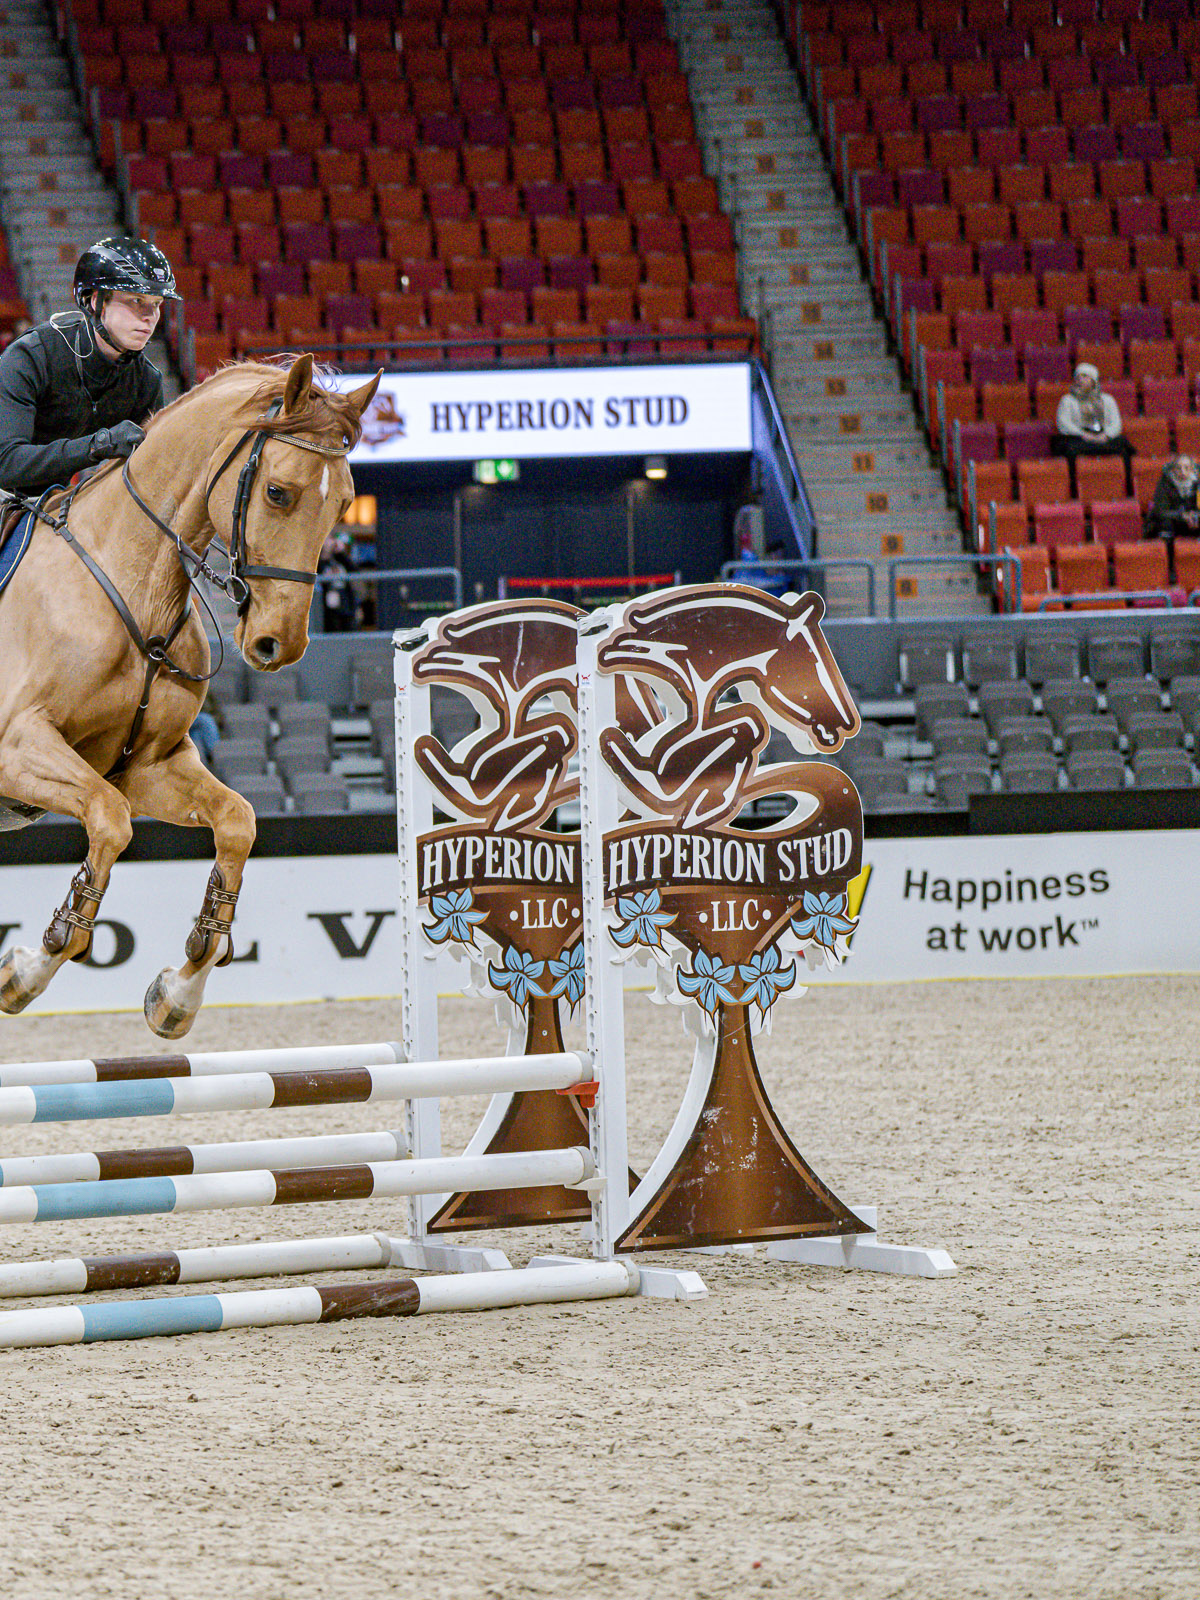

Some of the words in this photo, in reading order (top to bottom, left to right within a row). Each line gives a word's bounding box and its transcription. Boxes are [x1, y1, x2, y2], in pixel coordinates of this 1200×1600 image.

[430, 398, 594, 433] HYPERION
[604, 395, 690, 428] STUD
[421, 836, 575, 891] HYPERION
[607, 834, 765, 892] HYPERION
[777, 828, 852, 882] STUD
[902, 867, 1110, 911] Happiness
[521, 898, 569, 930] LLC
[711, 899, 760, 932] LLC
[926, 922, 968, 951] at
